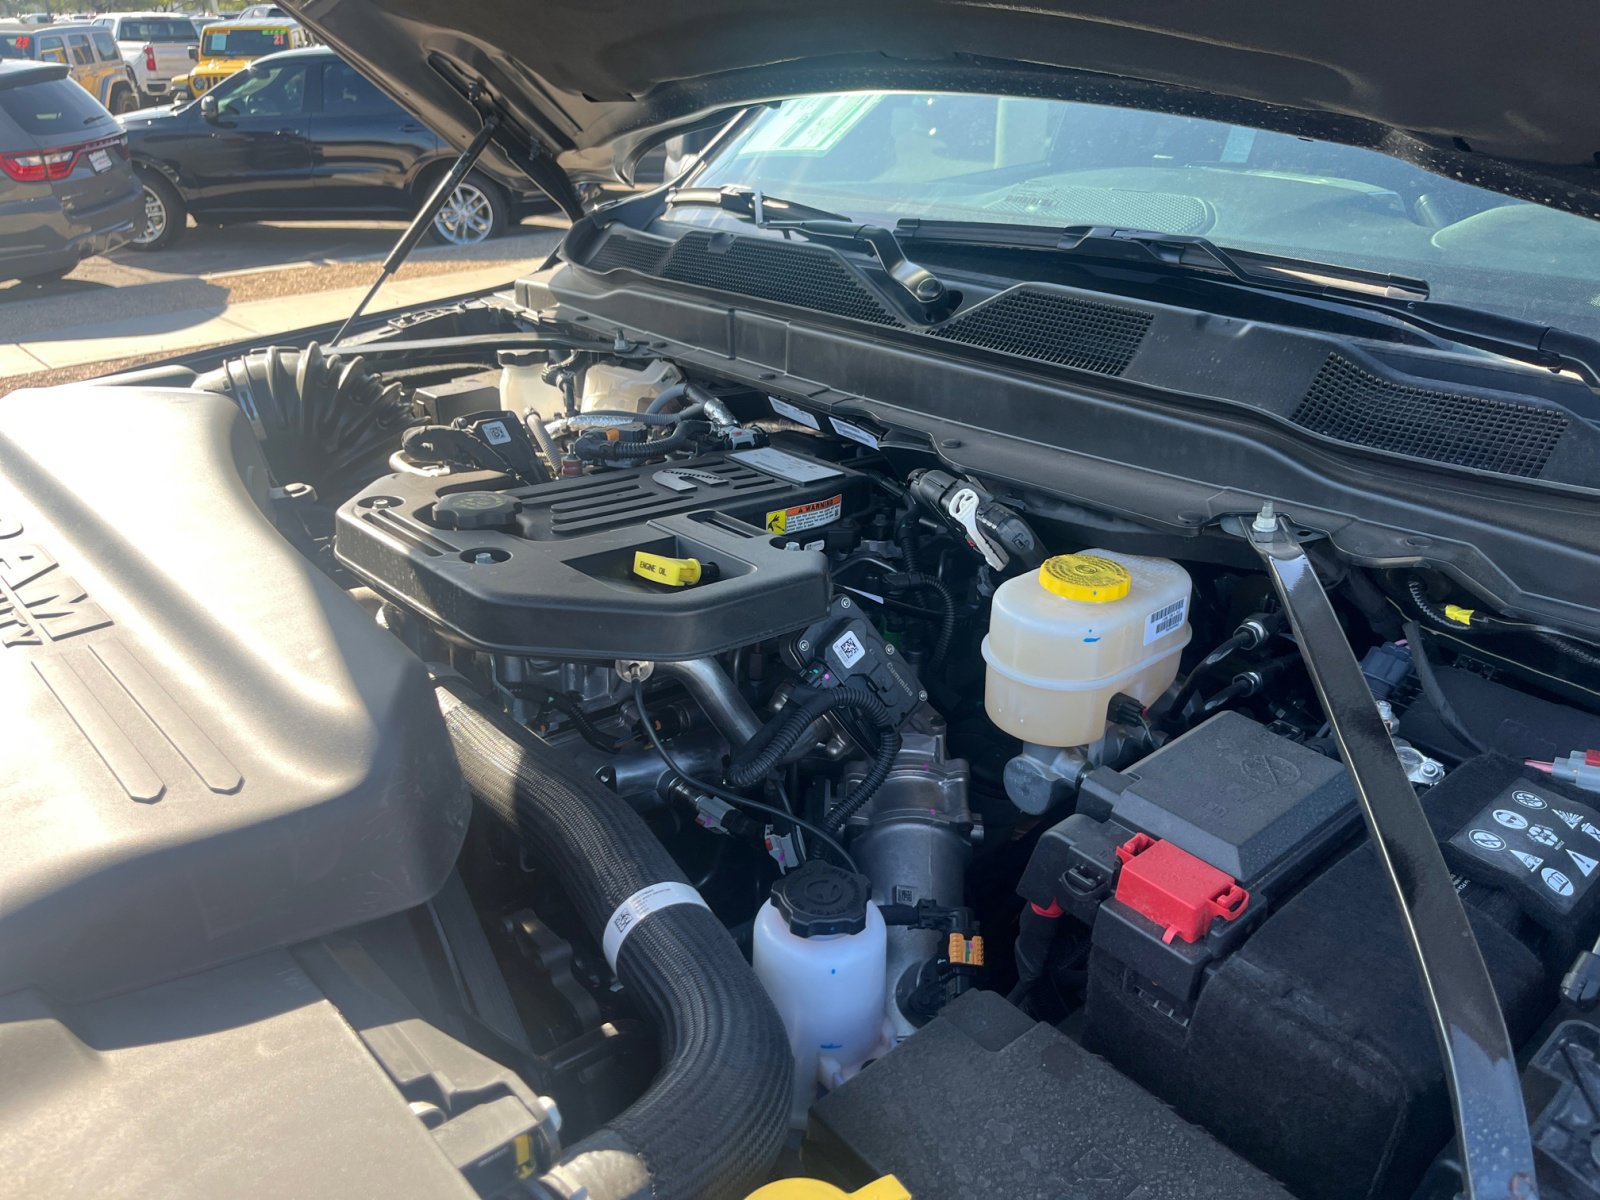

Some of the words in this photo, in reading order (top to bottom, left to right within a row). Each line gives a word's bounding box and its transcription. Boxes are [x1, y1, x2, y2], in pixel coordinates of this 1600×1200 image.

[806, 499, 834, 512] WARNING
[640, 560, 656, 573] ENGINE
[658, 567, 667, 577] OIL
[886, 662, 913, 697] Cummins
